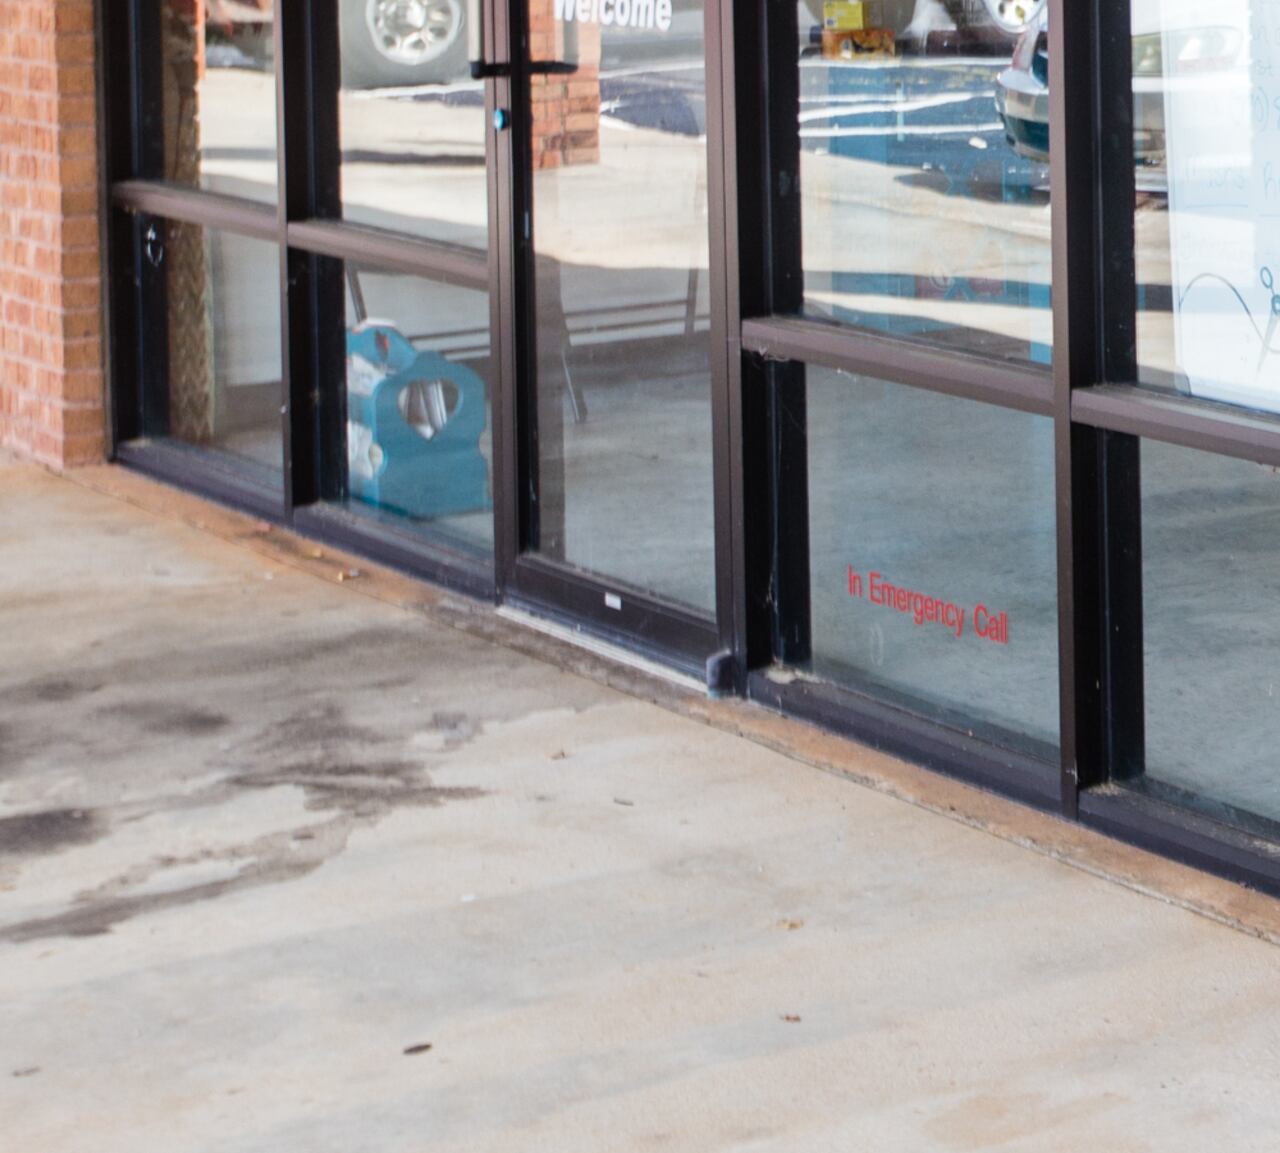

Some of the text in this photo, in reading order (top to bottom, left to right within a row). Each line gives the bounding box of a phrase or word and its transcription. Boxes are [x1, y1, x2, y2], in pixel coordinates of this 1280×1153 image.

[847, 565, 1009, 644] In Emergency Call
